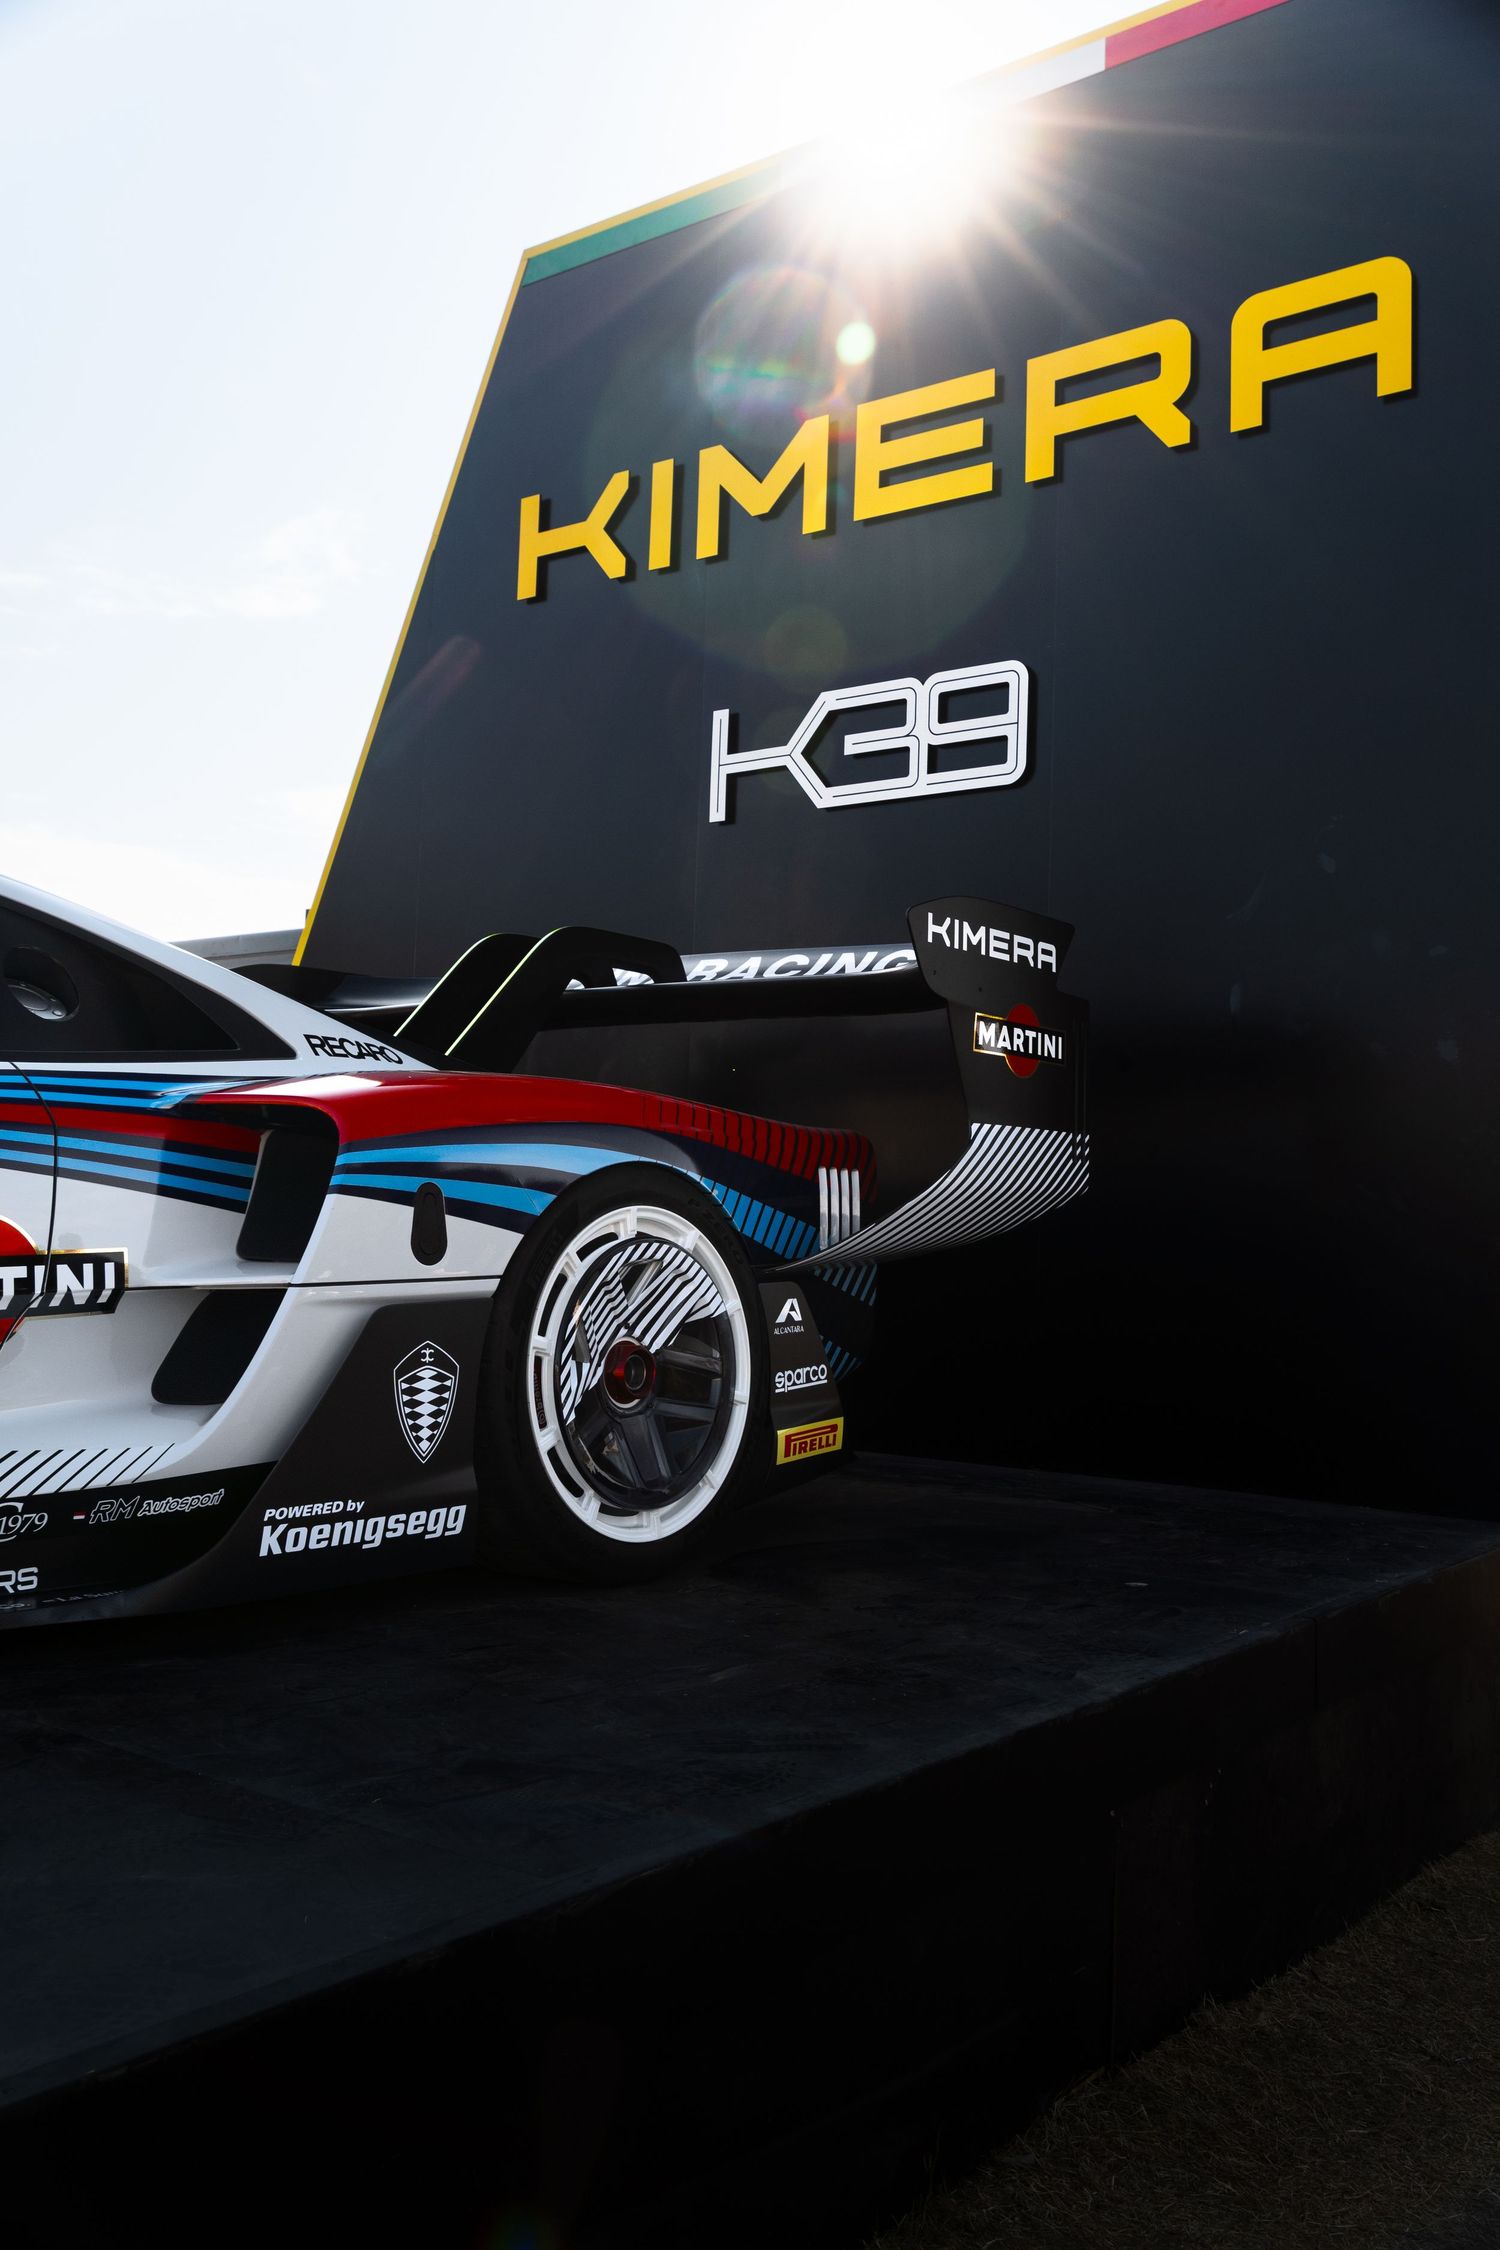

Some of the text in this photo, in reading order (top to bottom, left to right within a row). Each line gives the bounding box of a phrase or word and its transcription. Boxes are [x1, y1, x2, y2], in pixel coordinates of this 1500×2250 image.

[517, 256, 1413, 601] KIMERA
[709, 659, 1030, 824] K39
[927, 911, 1057, 974] KIMERA
[303, 1034, 404, 1065] RECARO
[977, 1020, 1063, 1060] MARTINI
[773, 1325, 805, 1335] ALCANTARA
[775, 1363, 828, 1393] sparco
[783, 1423, 839, 1458] PIRELLI
[89, 1488, 225, 1525] RM Autosport
[263, 1500, 365, 1521] POWERED by
[258, 1504, 467, 1558] Koenigsegg
